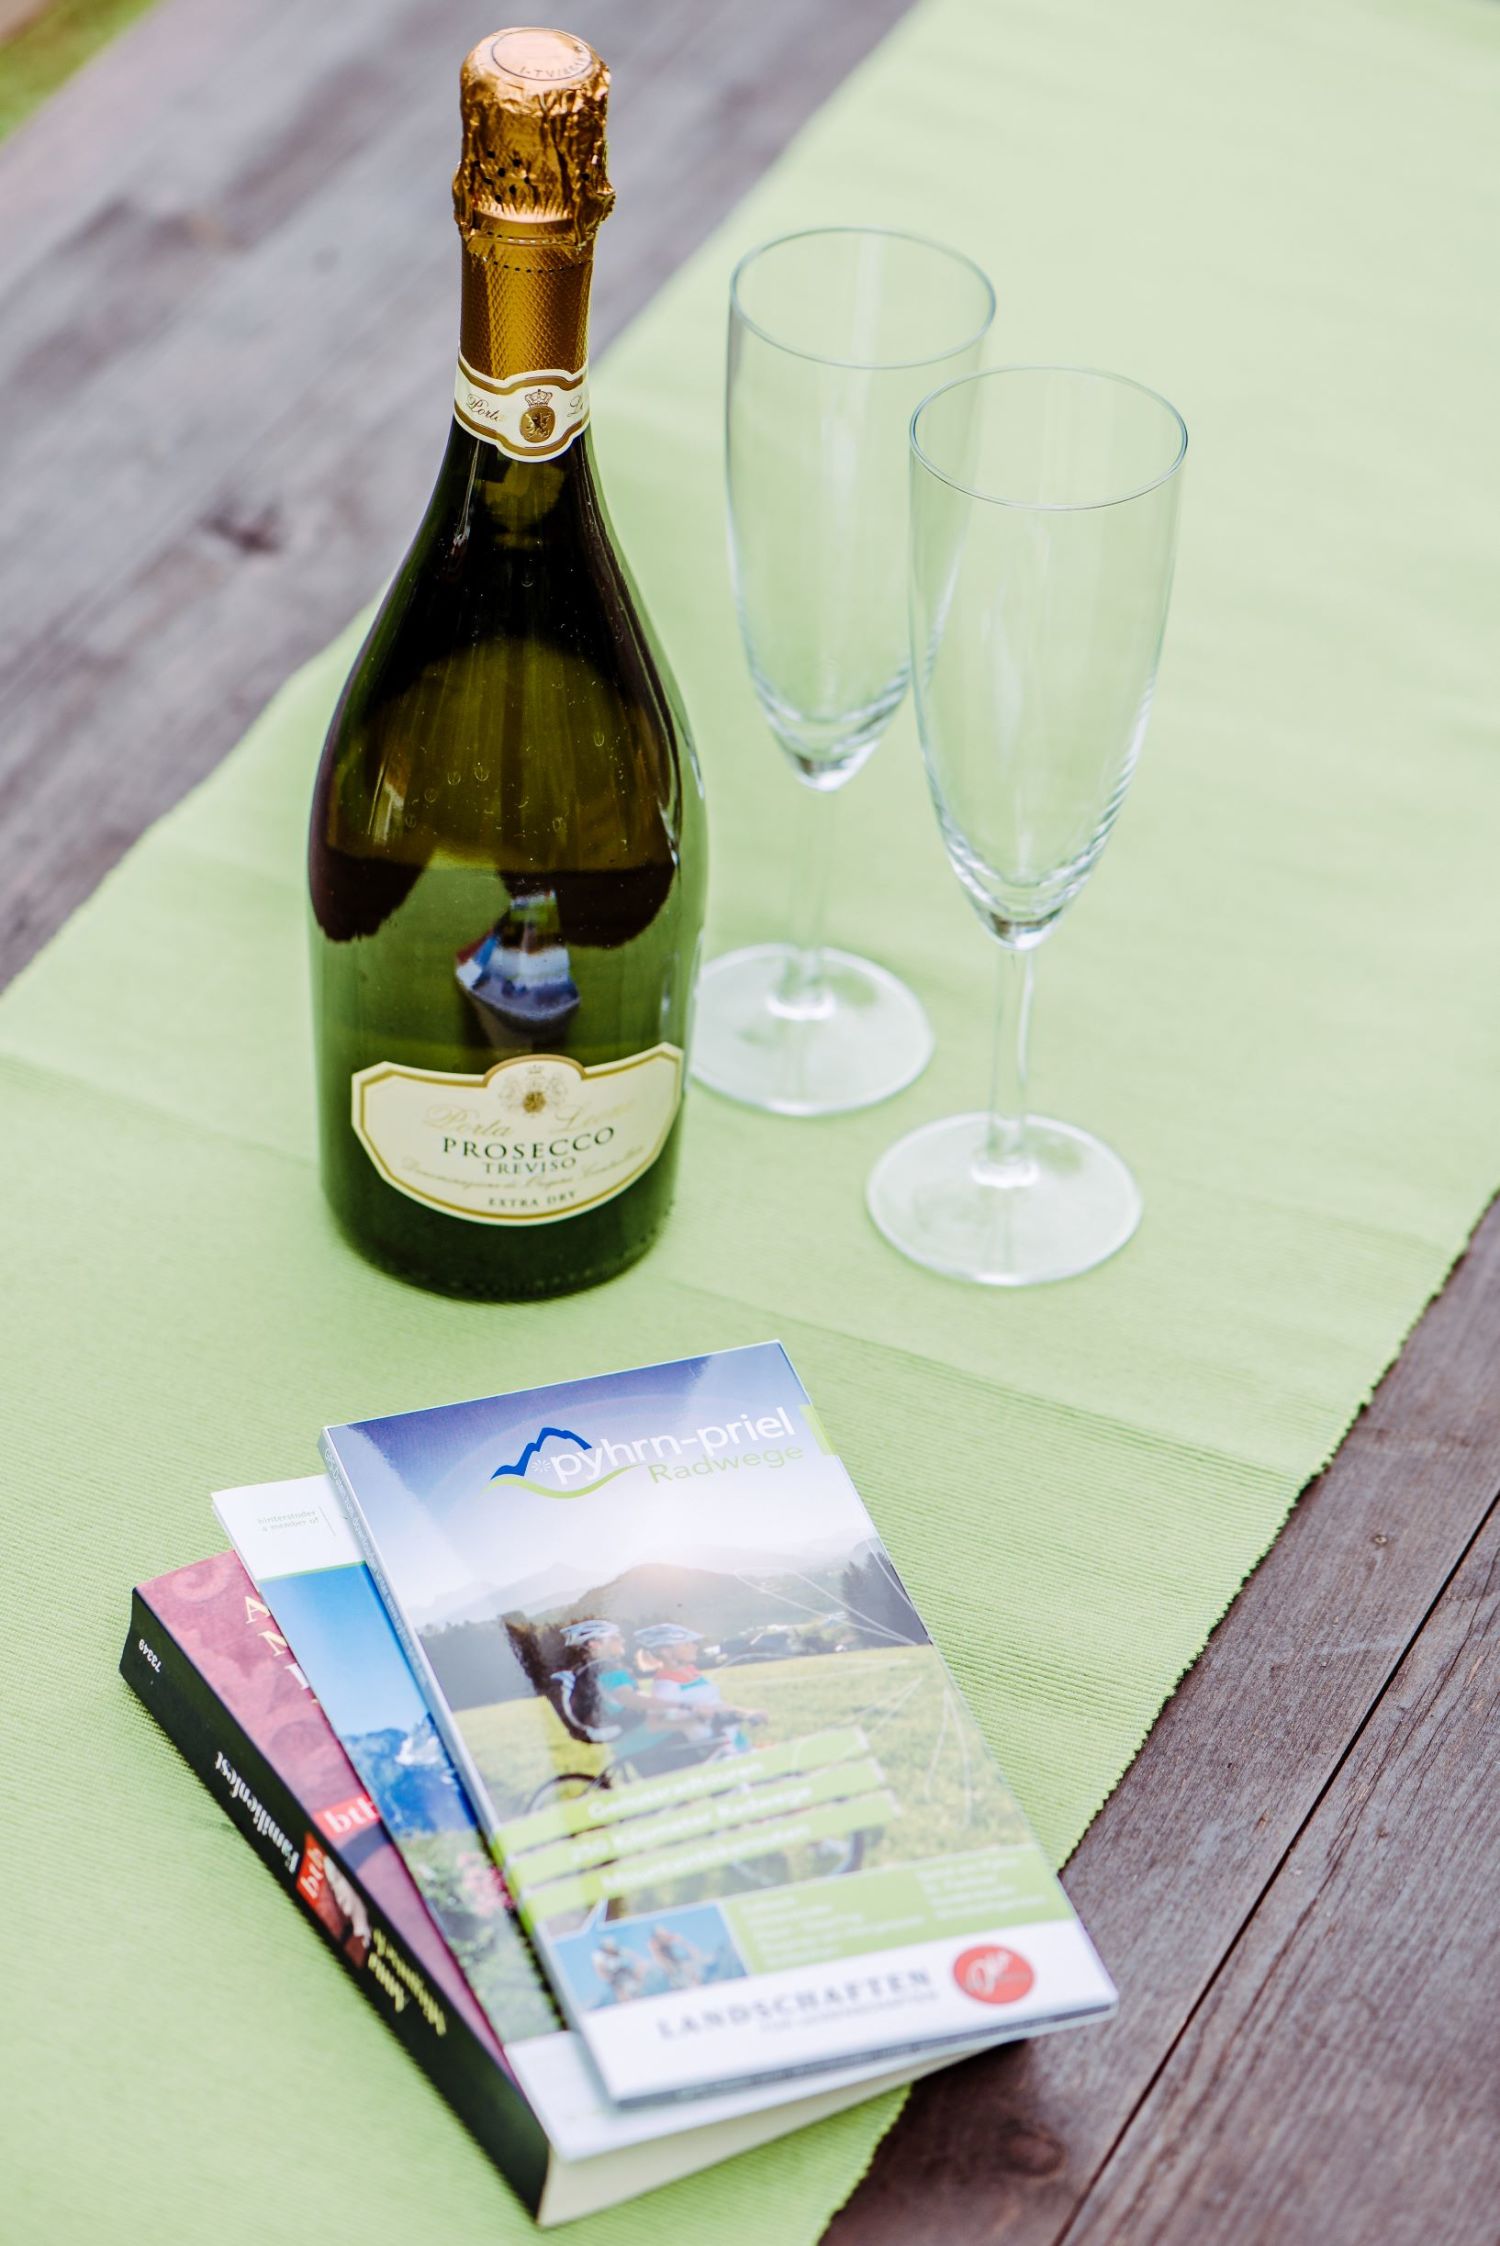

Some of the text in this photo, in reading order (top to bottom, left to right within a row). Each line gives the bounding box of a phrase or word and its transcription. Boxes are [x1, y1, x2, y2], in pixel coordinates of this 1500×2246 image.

[443, 1126, 614, 1160] PROSECCO
[483, 1156, 577, 1175] TREVISO
[488, 1190, 577, 1209] EXTRA DRY
[550, 1406, 798, 1485] pyhrn-priel
[648, 1445, 805, 1484] Radwege
[215, 1751, 300, 1874] Familienfest
